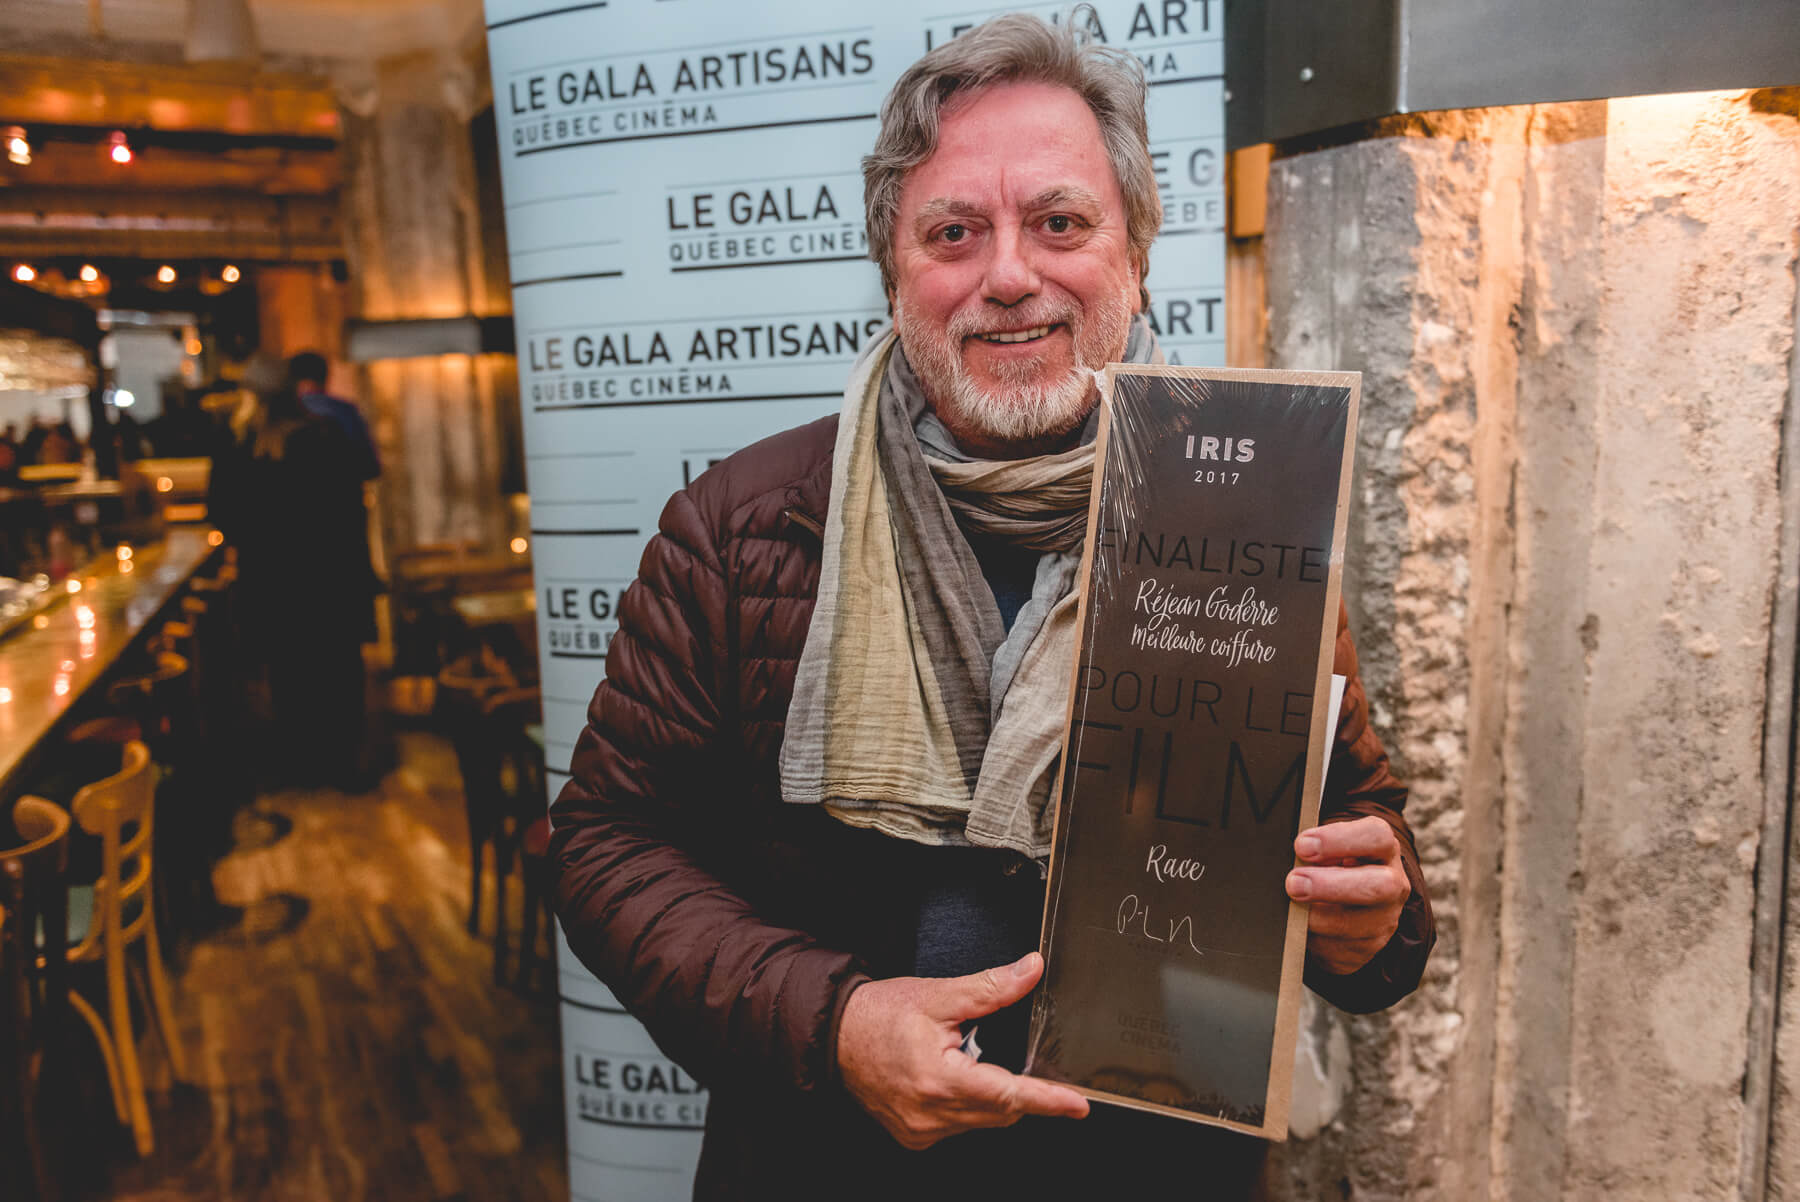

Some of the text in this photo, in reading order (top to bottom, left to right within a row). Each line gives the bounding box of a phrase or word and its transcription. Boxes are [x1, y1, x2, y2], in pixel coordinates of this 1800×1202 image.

[510, 39, 874, 116] LE GALA ARTISANS
[513, 101, 718, 147] QUÉBEC CINÉMA
[667, 184, 838, 231] LE GALA
[670, 232, 777, 262] QUÉBEC
[529, 338, 564, 372] LE
[574, 331, 672, 369] GALA
[630, 369, 733, 396] CINÉMA
[1185, 434, 1256, 463] IRIS
[1194, 470, 1240, 486] 2017
[1098, 527, 1325, 584] FINALISTE
[546, 587, 578, 619] LE
[1135, 578, 1200, 630] Réjean
[1211, 629, 1276, 668] coiffure
[1074, 665, 1314, 737] POUR LE
[1064, 718, 1307, 841] FILM
[1146, 844, 1205, 883] Race
[575, 1054, 610, 1089] LE
